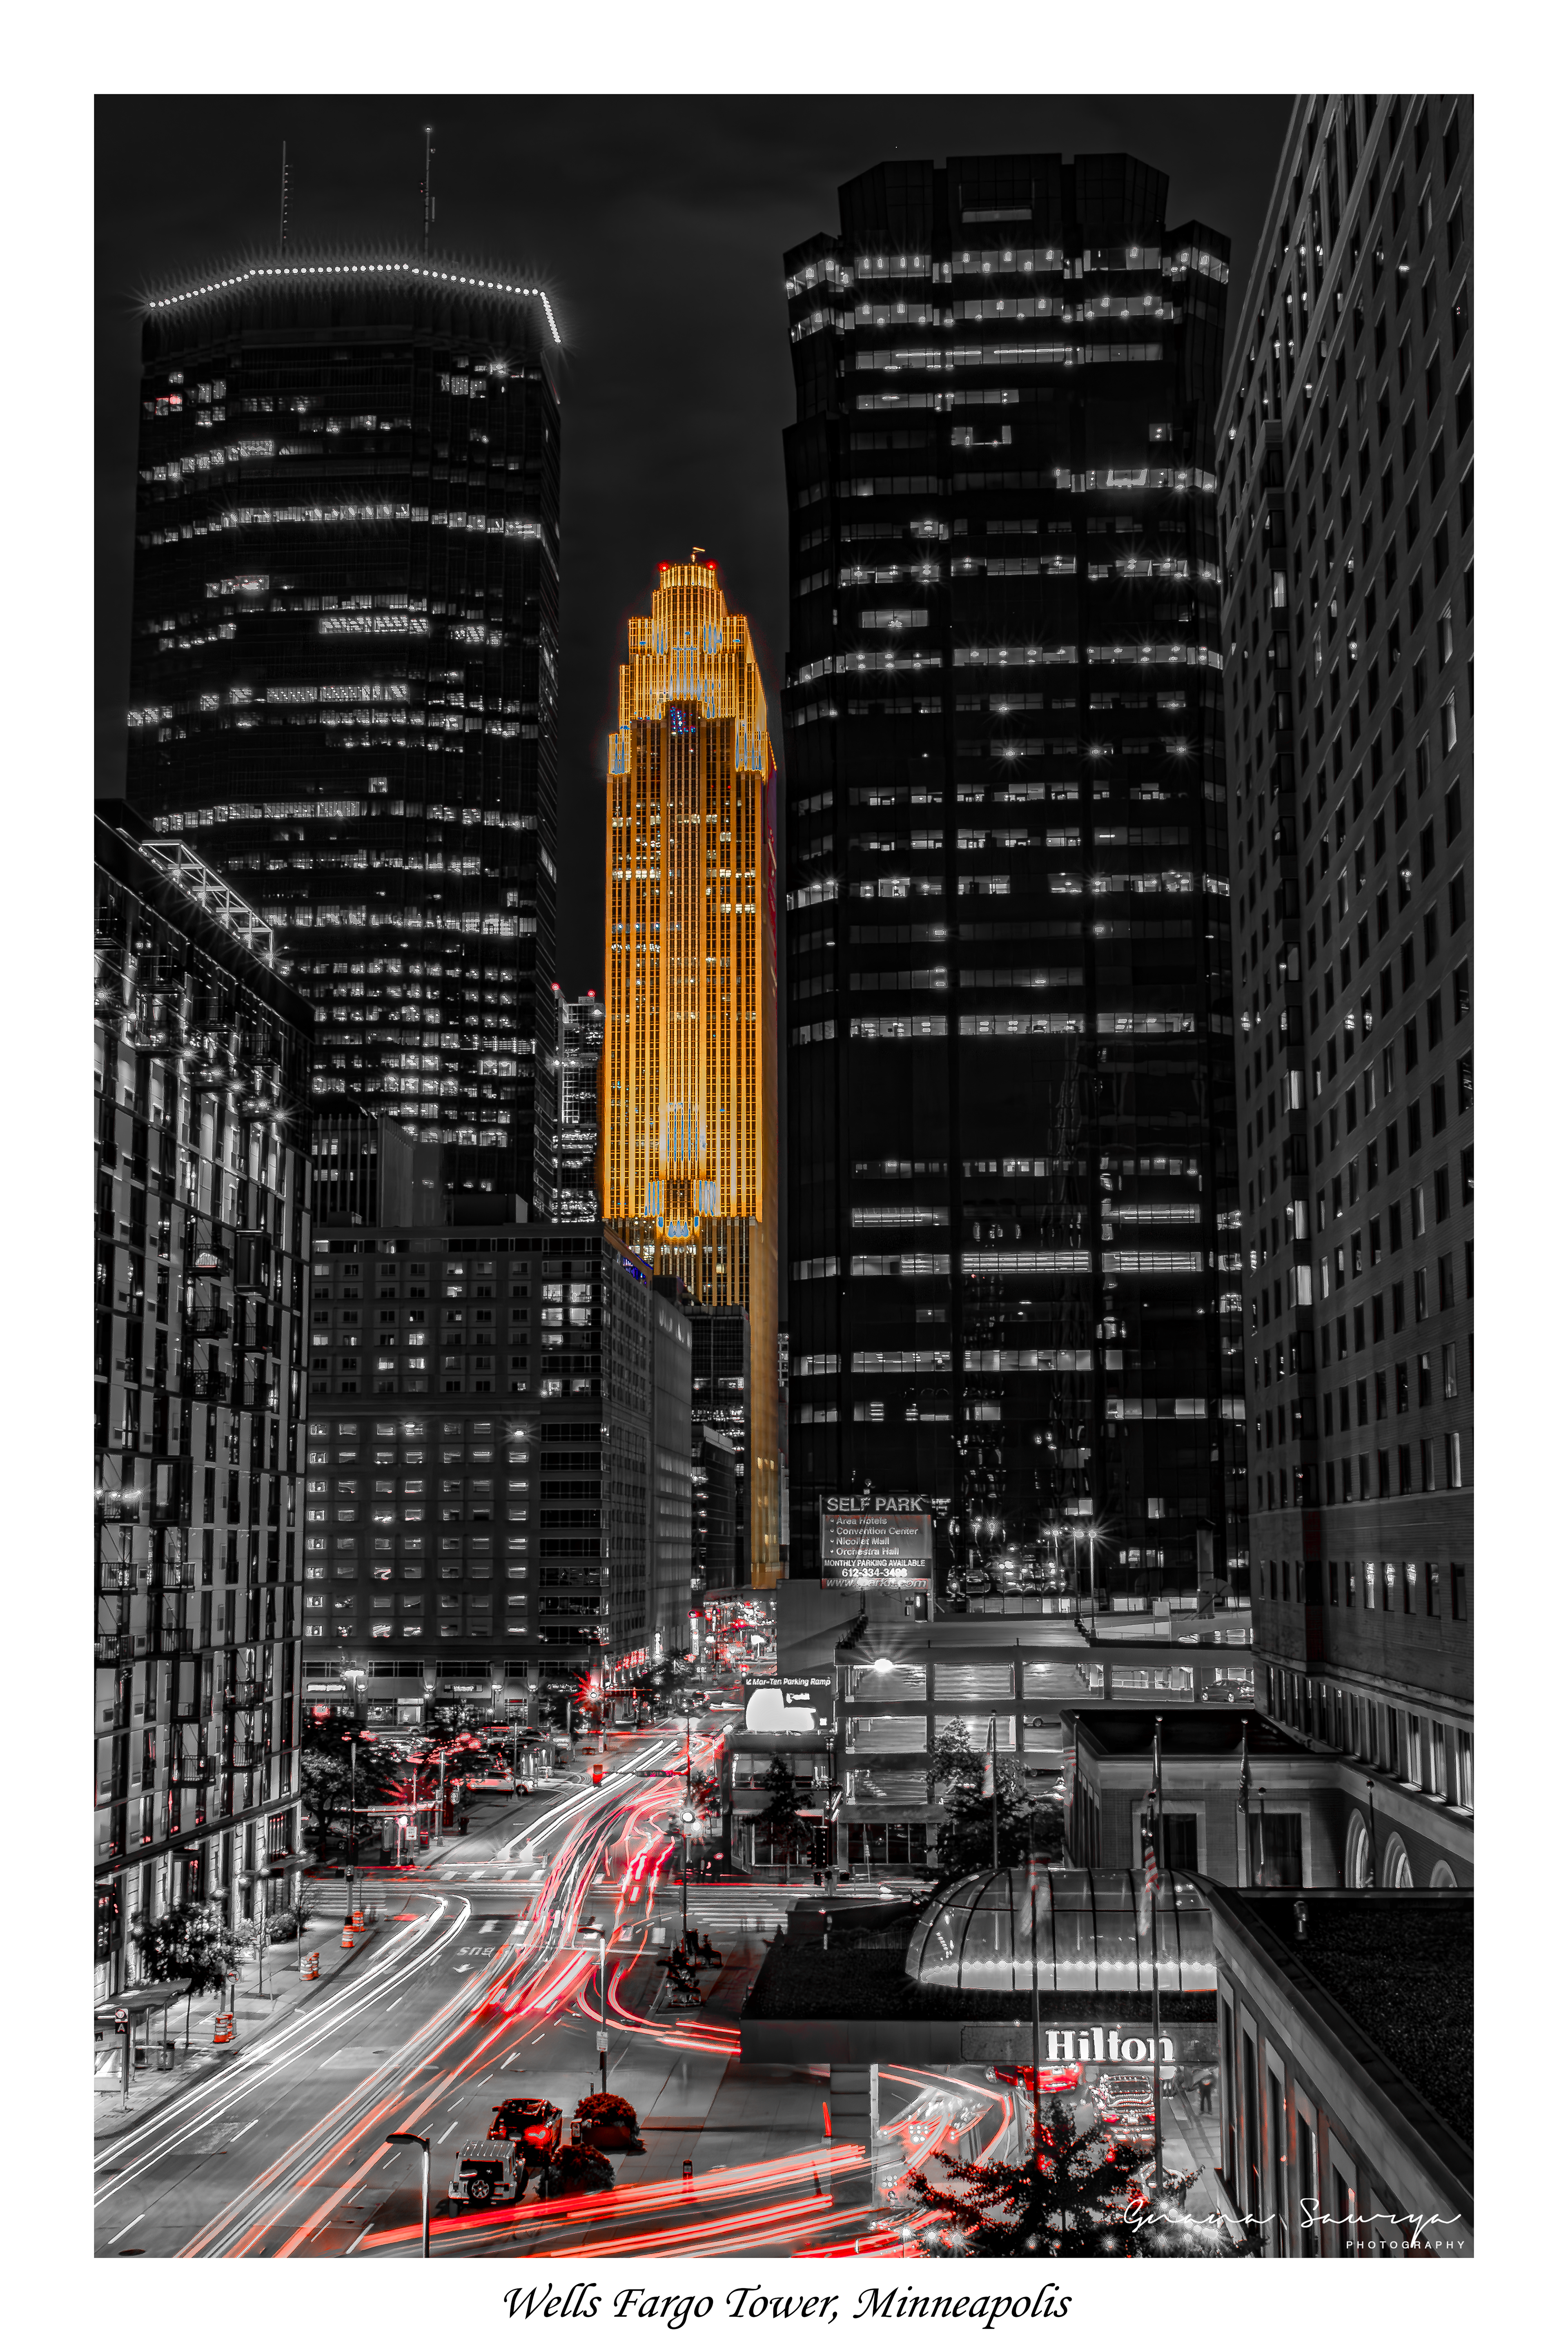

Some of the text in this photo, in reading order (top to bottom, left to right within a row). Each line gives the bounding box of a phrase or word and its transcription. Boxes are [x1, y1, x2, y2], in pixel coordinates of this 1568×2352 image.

[827, 1497, 922, 1511] SELF PARK
[836, 1516, 887, 1525] Area Hotels
[836, 1526, 918, 1535] Convention Center
[836, 1537, 890, 1545] Nicollet Mall
[836, 1547, 900, 1556] Orchestra Hall
[783, 1678, 809, 1686] Parking
[810, 1678, 831, 1686] Ramp
[1045, 2027, 1176, 2062] Hilton
